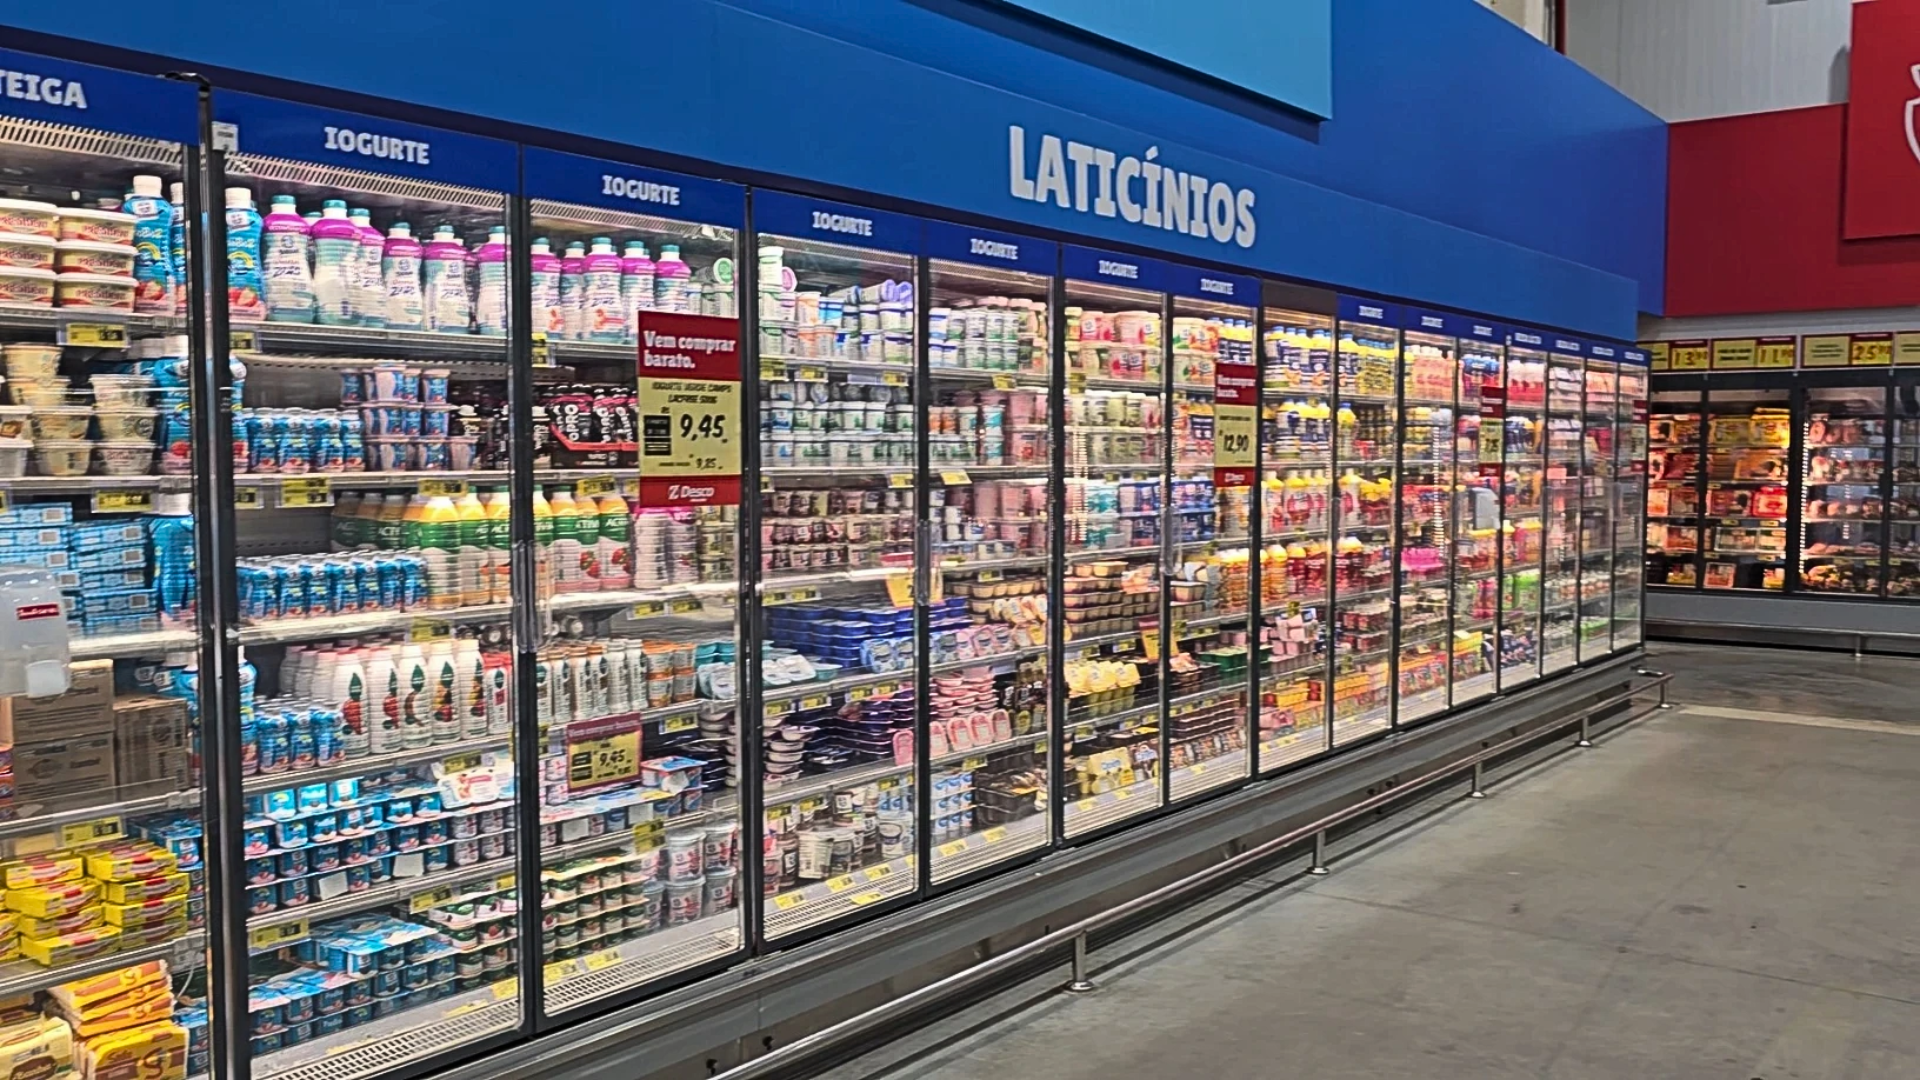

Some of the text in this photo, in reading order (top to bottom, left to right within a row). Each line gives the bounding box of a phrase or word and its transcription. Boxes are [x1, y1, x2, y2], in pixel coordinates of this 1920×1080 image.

[324, 126, 430, 165] IOGURTE
[602, 174, 680, 206] IOGURTE
[1009, 125, 1256, 248] LATICÍNIOS
[812, 211, 873, 236] IOGURTE
[970, 238, 1018, 260] IOGURTE
[1098, 259, 1139, 279] IOGURTE
[643, 330, 736, 355] Vem comprar
[643, 349, 696, 368] barato.
[680, 413, 726, 441] 9,45
[680, 485, 715, 498] Desco
